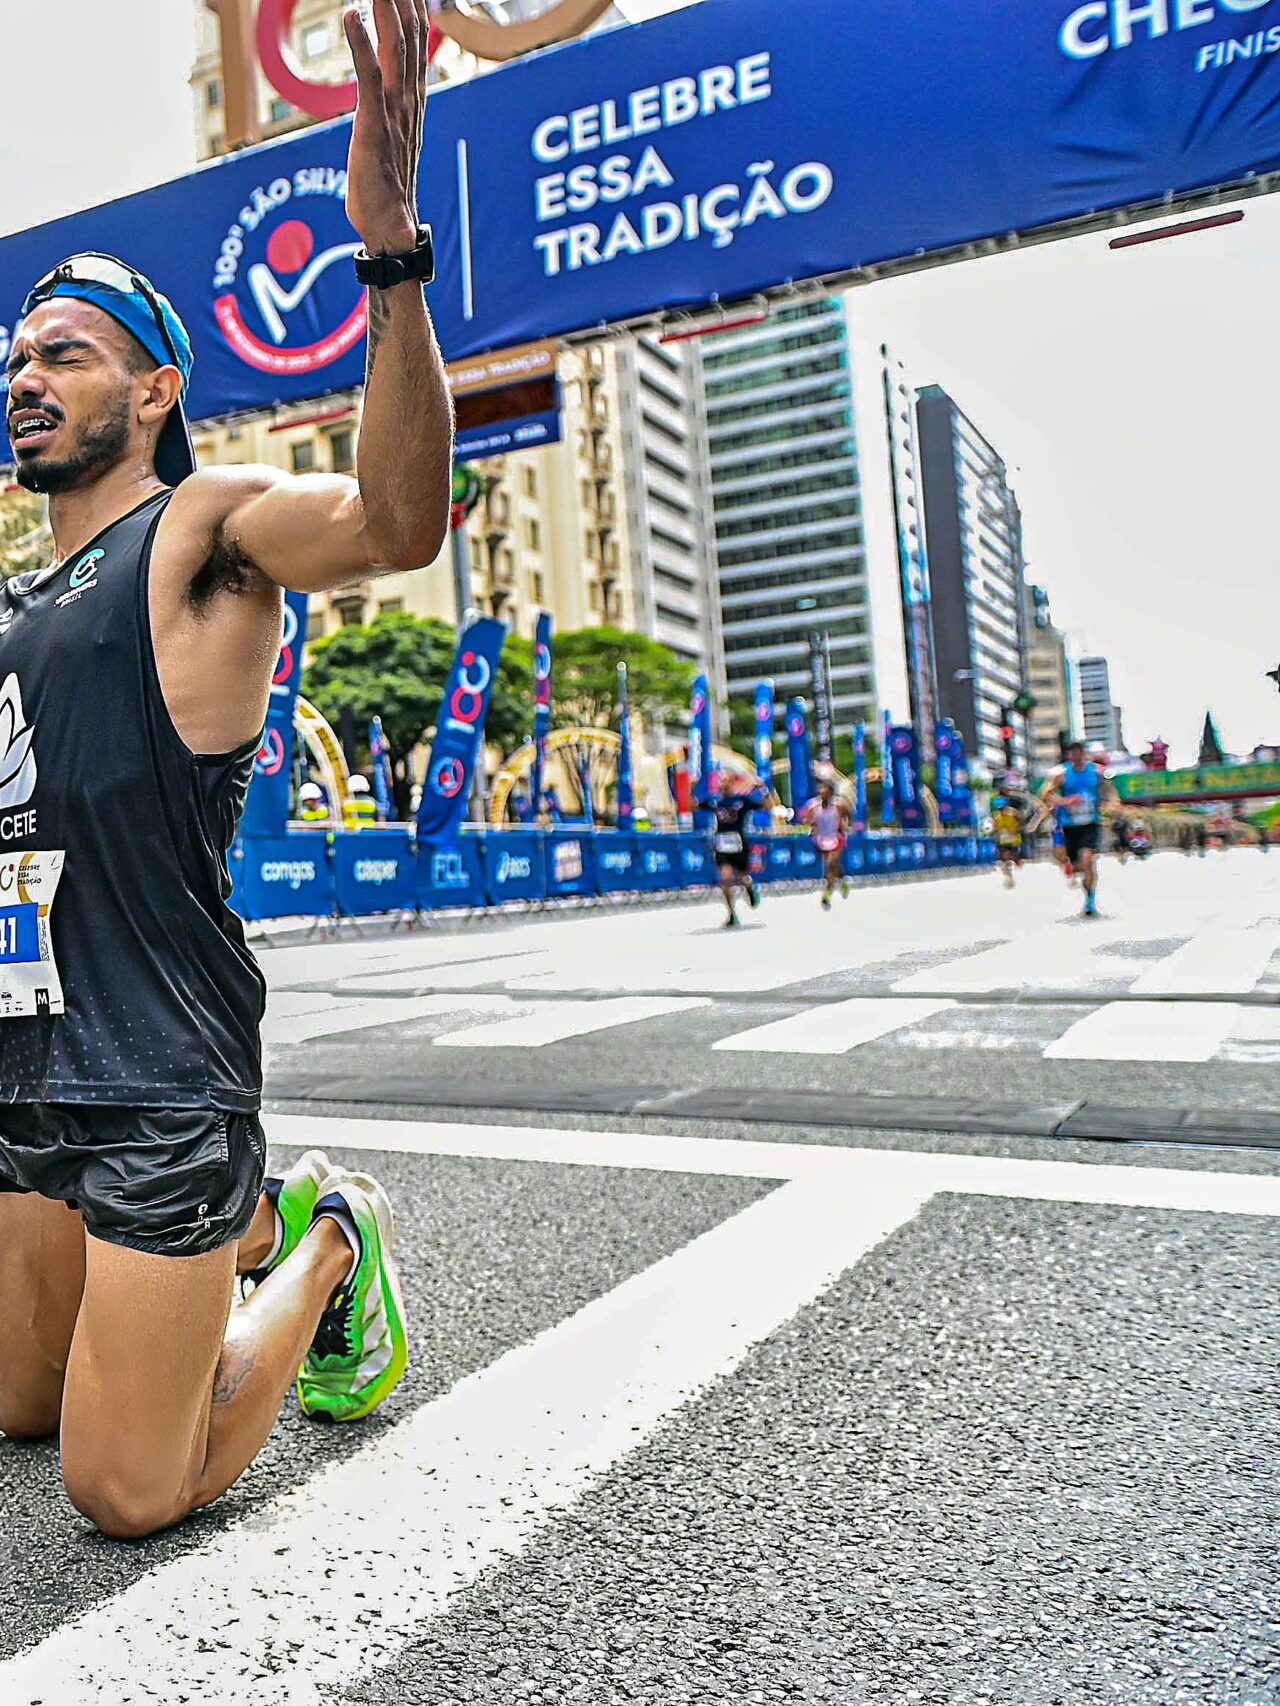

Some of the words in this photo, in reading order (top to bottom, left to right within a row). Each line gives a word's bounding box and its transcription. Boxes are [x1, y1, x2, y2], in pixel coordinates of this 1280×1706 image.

[1057, 0, 1276, 60] CHE
[531, 51, 771, 163] CELEBRE
[533, 160, 833, 276] TRADIÇÃO
[535, 145, 674, 222] ESSA
[37, 991, 49, 1006] M
